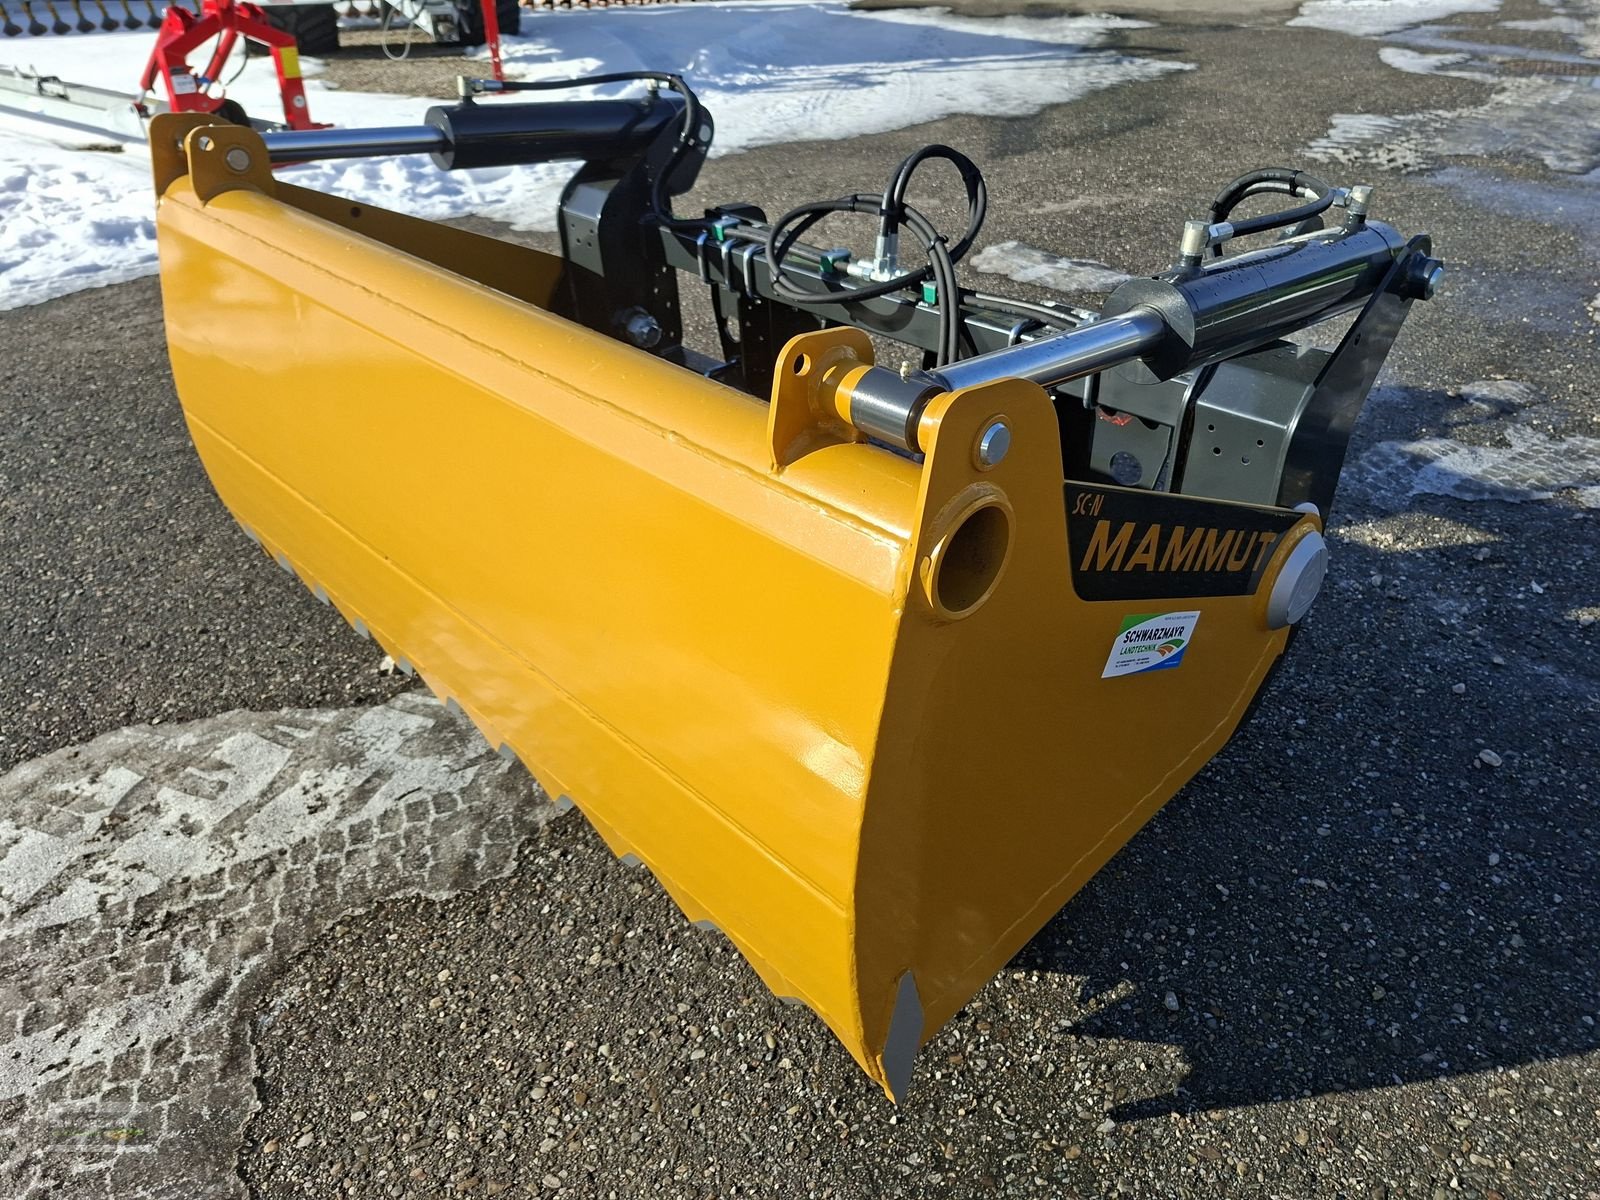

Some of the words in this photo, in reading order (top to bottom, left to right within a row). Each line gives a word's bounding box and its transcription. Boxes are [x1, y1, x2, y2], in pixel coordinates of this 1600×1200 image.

[1079, 519, 1278, 572] MAMMUT
[1122, 625, 1185, 644] SCHWARZMAYR
[1119, 643, 1158, 656] LANDTECHNIK
